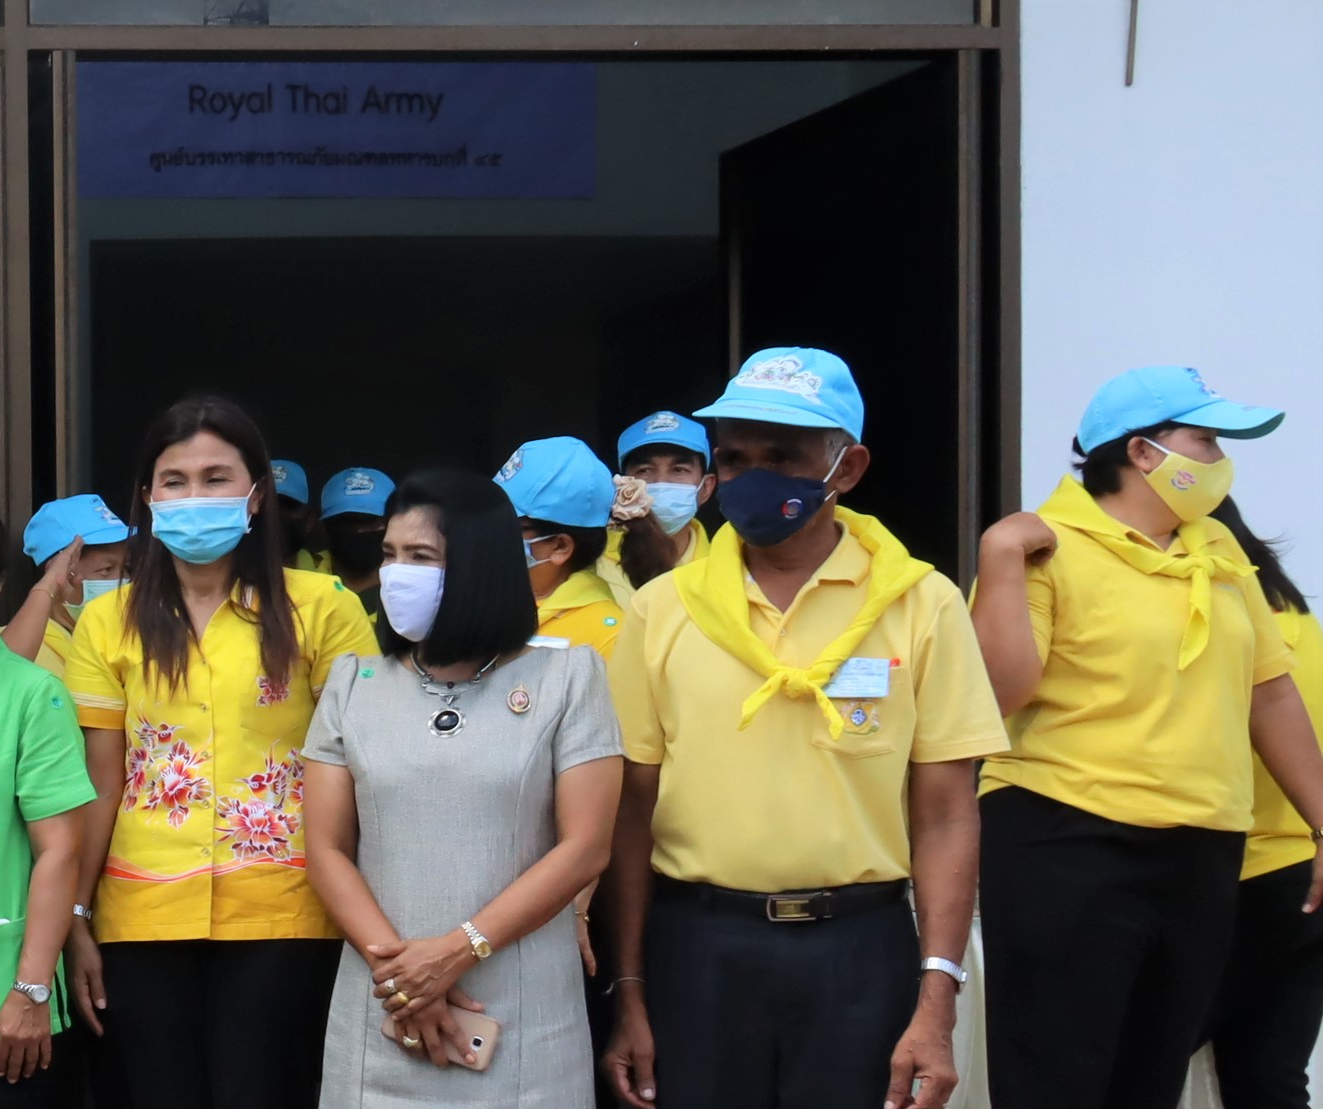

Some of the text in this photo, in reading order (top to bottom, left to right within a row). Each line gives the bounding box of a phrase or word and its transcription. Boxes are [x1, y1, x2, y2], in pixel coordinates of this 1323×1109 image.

[188, 83, 445, 123] Royal Thai Army
